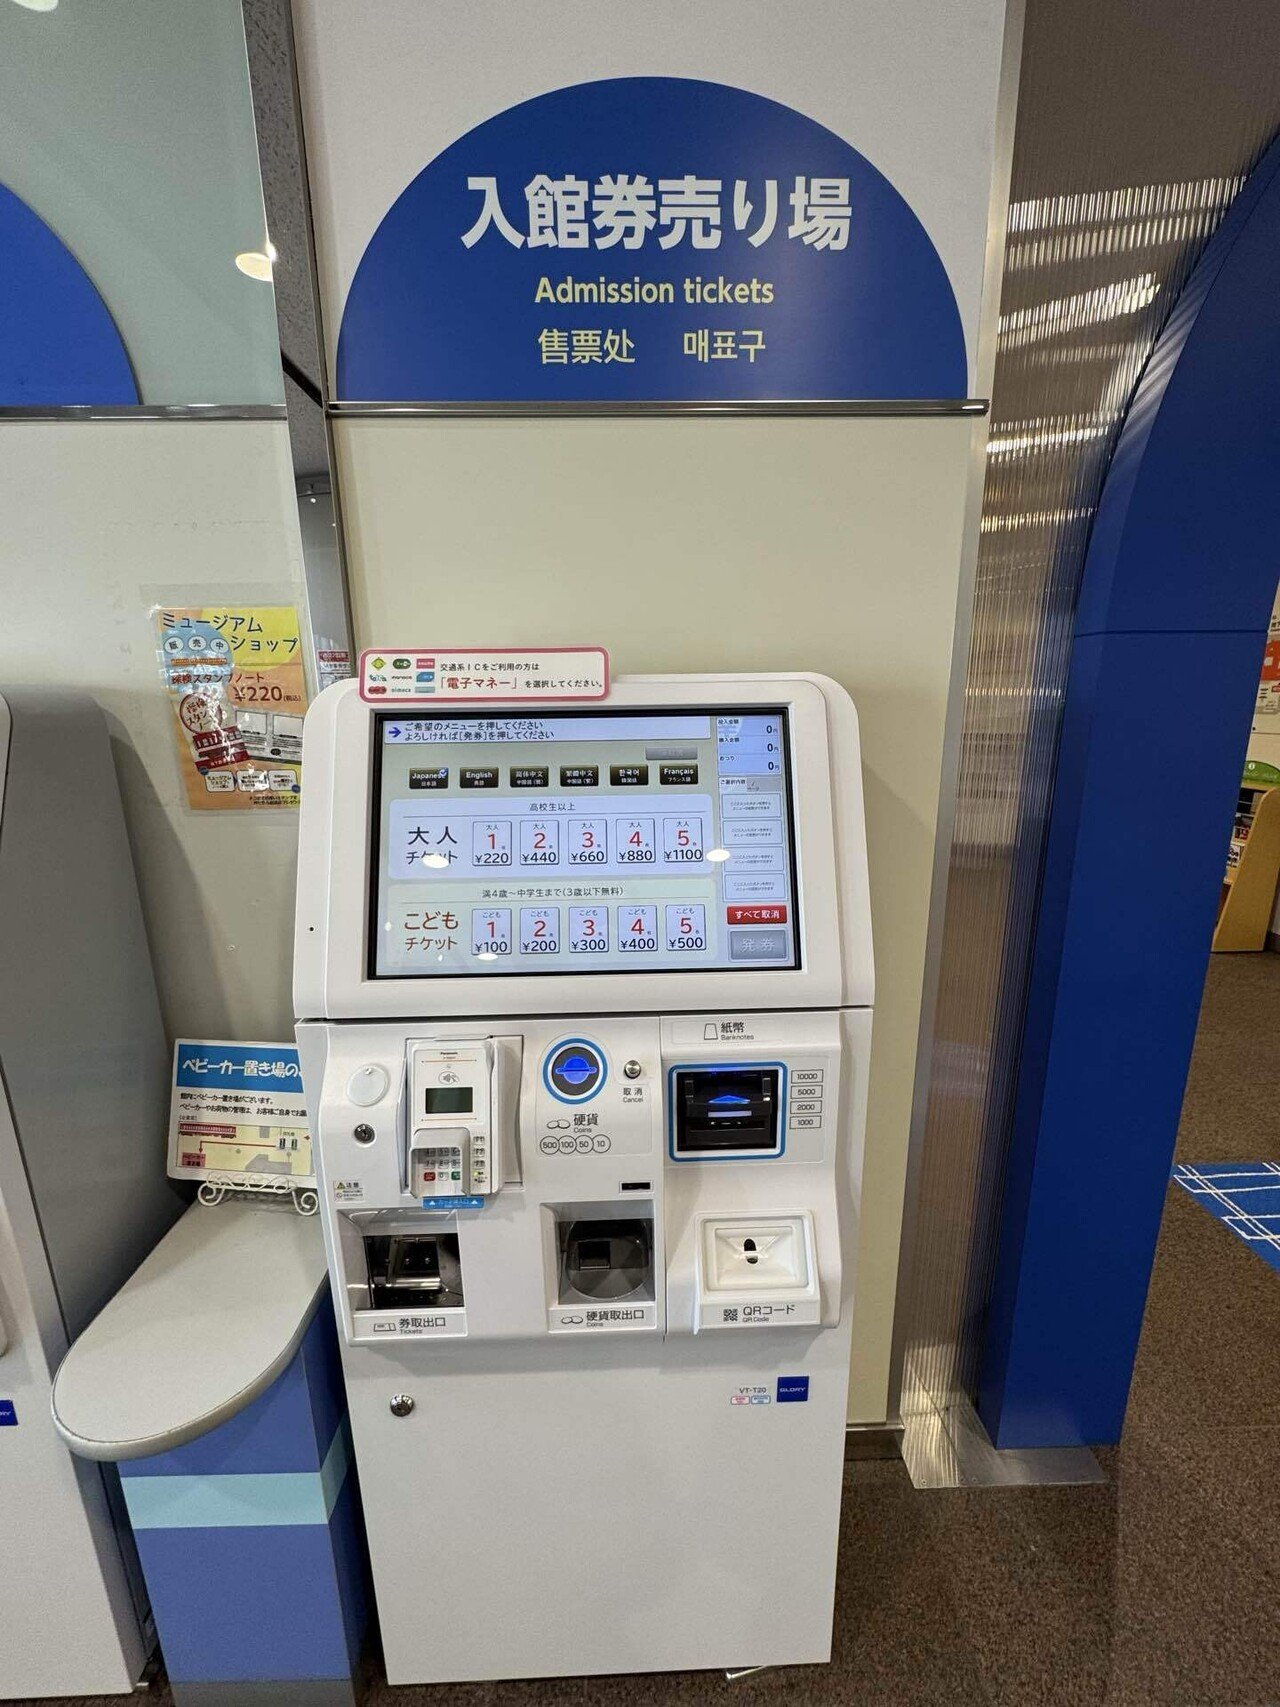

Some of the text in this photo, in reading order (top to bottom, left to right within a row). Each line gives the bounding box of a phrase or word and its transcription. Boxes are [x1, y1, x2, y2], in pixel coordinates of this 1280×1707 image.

[461, 174, 852, 251] 入館券売り場
[534, 275, 774, 304] Admission tickets
[538, 327, 636, 365] 售票处
[683, 328, 766, 364] 매표구
[162, 612, 264, 633] ミュージアム
[230, 635, 299, 653] ショップ
[233, 686, 283, 702] ¥220
[405, 721, 543, 731] ご希望のメニューを押してください
[404, 731, 555, 741] よろしければ[発券]を押してください
[465, 771, 493, 780] English
[663, 767, 694, 776] Français
[529, 802, 577, 812] 高校生以上
[408, 825, 458, 845] 大人
[475, 853, 509, 864] ¥220
[522, 852, 557, 863] ¥440
[571, 851, 605, 862] ¥660
[619, 850, 653, 861] ¥880
[664, 849, 702, 860] ¥1100
[404, 911, 459, 930] こども
[734, 910, 780, 920] すべて取消
[405, 936, 458, 951] チケット
[475, 941, 508, 953] ¥100
[522, 940, 557, 951] ¥200
[571, 939, 606, 950] ¥300
[620, 938, 655, 949] ¥400
[669, 937, 703, 949] ¥500
[721, 1022, 745, 1033] 紙幣
[182, 1058, 303, 1078] ベビーカー置き場の
[623, 1087, 643, 1096] 取消
[797, 1103, 815, 1111] 2000
[574, 1113, 599, 1126] 硬貨
[543, 1141, 557, 1149] 500
[579, 1140, 589, 1148] 50
[586, 1310, 644, 1321] 硬貨取出口
[743, 1304, 796, 1316] QRコード
[399, 1317, 446, 1328] 券取出口
